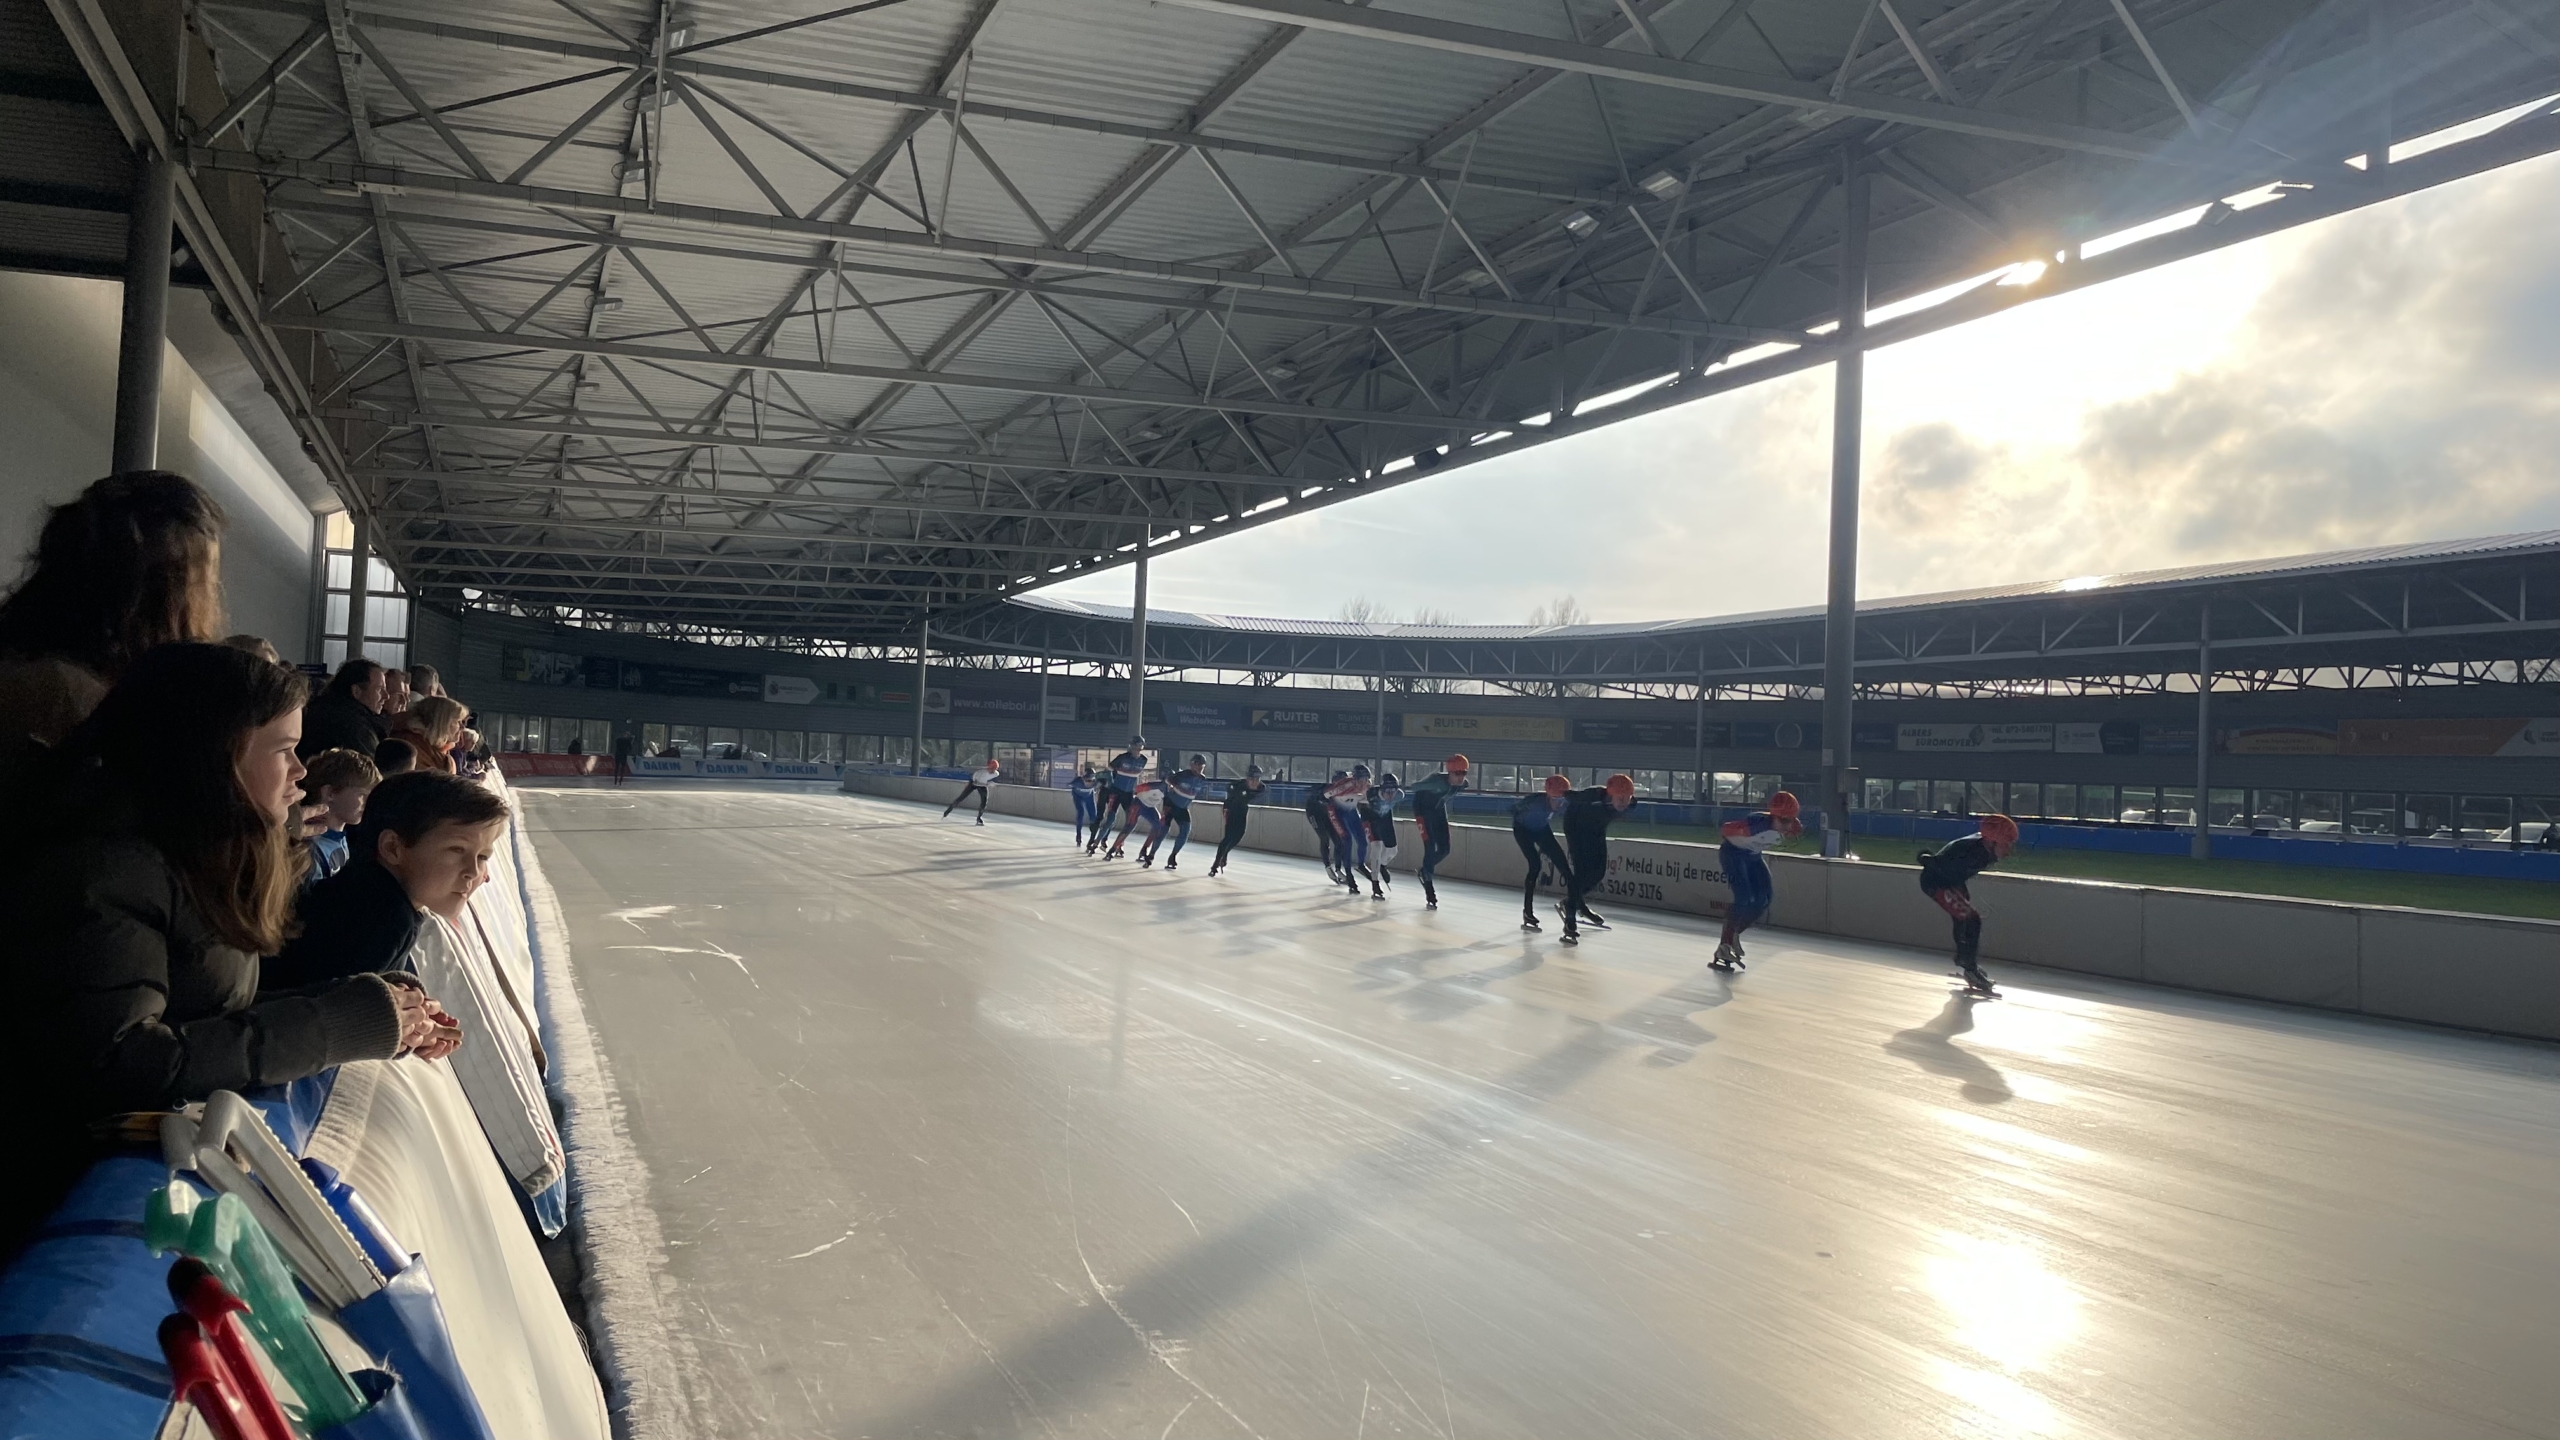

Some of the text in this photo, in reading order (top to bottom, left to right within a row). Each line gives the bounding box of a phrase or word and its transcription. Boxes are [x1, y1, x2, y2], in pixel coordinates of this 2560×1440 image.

[1176, 704, 1218, 716] Websites
[1179, 715, 1227, 727] Webshops
[1273, 710, 1319, 723] RUITER
[1433, 717, 1478, 728] RUITER
[1337, 722, 1347, 731] TE
[1900, 728, 1933, 738] ALBERS
[643, 760, 819, 776] DAIKIN DAIKIN DAIKIN
[1626, 857, 1653, 875] Meld
[1655, 863, 1663, 876] u
[1666, 859, 1680, 882] bij
[1683, 862, 1697, 879] de
[1607, 879, 1636, 897] 5249
[1638, 882, 1663, 902] 3176
